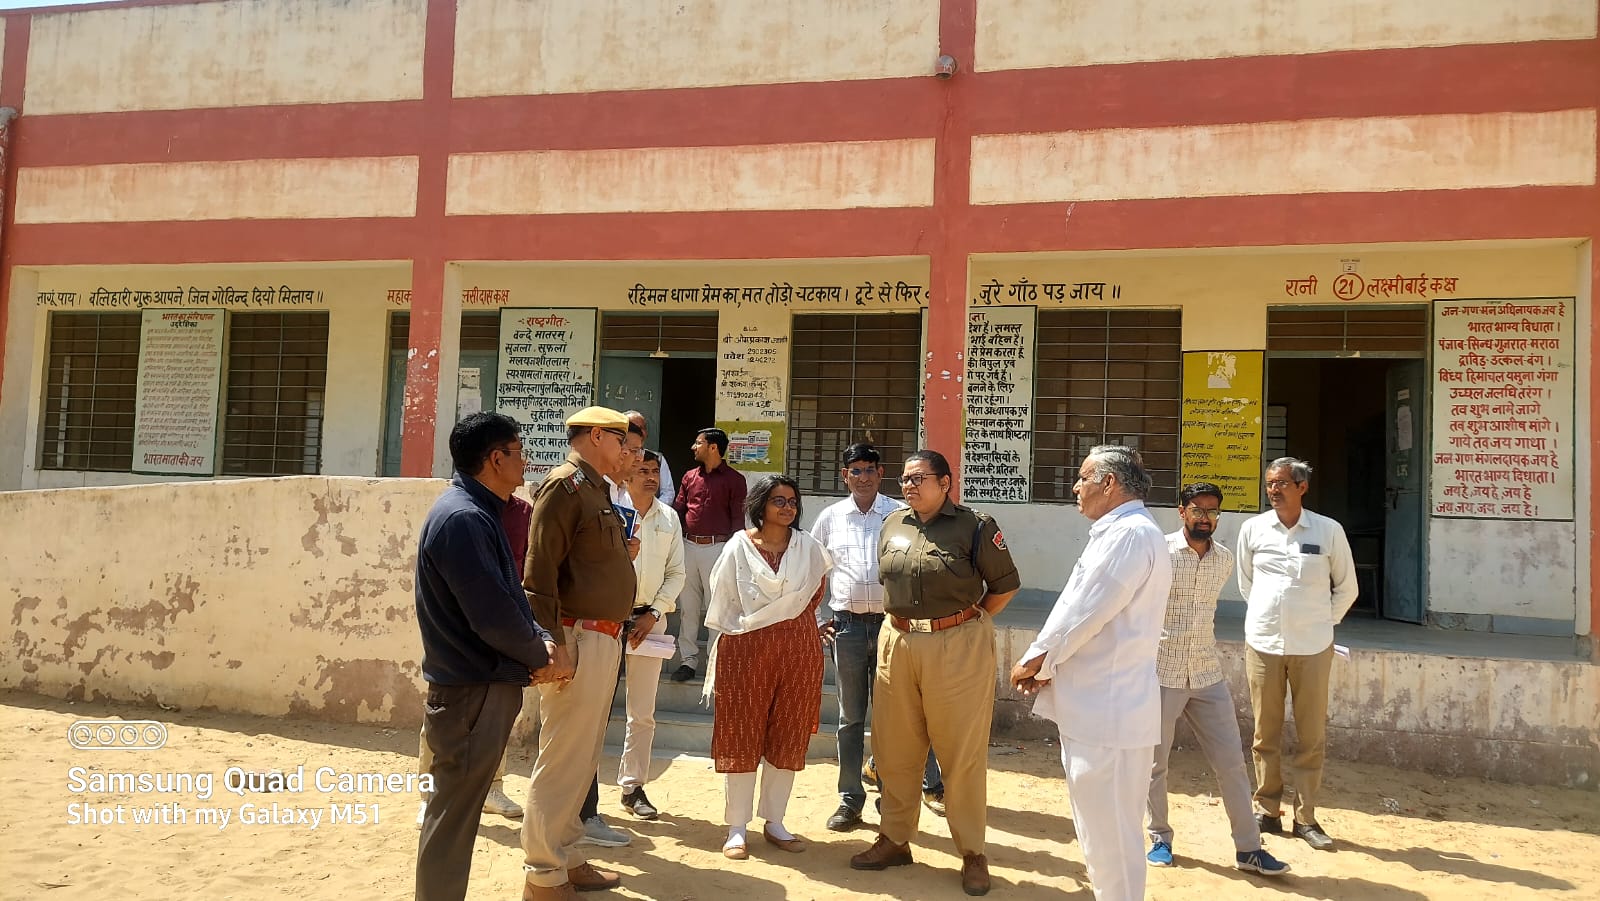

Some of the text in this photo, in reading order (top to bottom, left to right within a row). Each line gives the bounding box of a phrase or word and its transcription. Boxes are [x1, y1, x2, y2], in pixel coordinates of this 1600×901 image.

[628, 283, 669, 305] रहिमन
[670, 288, 700, 303] धागा
[742, 287, 765, 304] मत
[765, 282, 793, 306] तोड़ो
[795, 286, 842, 303] चटकाय
[855, 282, 875, 305] टूटे
[878, 282, 893, 303] से
[895, 281, 922, 304] फिर
[979, 279, 1004, 304] जुरे
[1008, 277, 1038, 302] गाँठ
[1041, 283, 1066, 303] पड़
[1070, 282, 1107, 300] जाय
[1285, 273, 1459, 297] रानी 21 लक्ष्मीबाई कक्ष
[188, 286, 210, 305] जिन
[251, 286, 275, 306] दियो
[278, 285, 314, 304] मिलाय
[387, 289, 412, 305] महाक
[1541, 305, 1557, 315] जय
[1558, 302, 1566, 317] हे
[1468, 318, 1554, 333] भारत भाग्य विधाता
[513, 328, 566, 341] वन्दे मातरम्
[1466, 368, 1505, 384] हिमाचल
[1506, 371, 1534, 385] यमुना
[1537, 368, 1559, 381] गंगा
[1518, 385, 1544, 399] तरंग
[1451, 401, 1542, 418] तव शुभ नामे जागे
[1449, 420, 1465, 431] तव
[1467, 420, 1487, 435] शुभ
[1489, 417, 1526, 432] आशीष
[1449, 434, 1546, 450] गाये तव जय गाथा
[1434, 452, 1453, 464] जन
[1455, 453, 1474, 465] गण
[1531, 454, 1549, 466] जय
[1550, 450, 1559, 469] हे
[1455, 468, 1549, 484] भारत भाग्य विधाता
[1502, 486, 1521, 498] जय
[1523, 484, 1532, 500] हे
[1500, 503, 1521, 514] जय
[1523, 501, 1532, 516] हे
